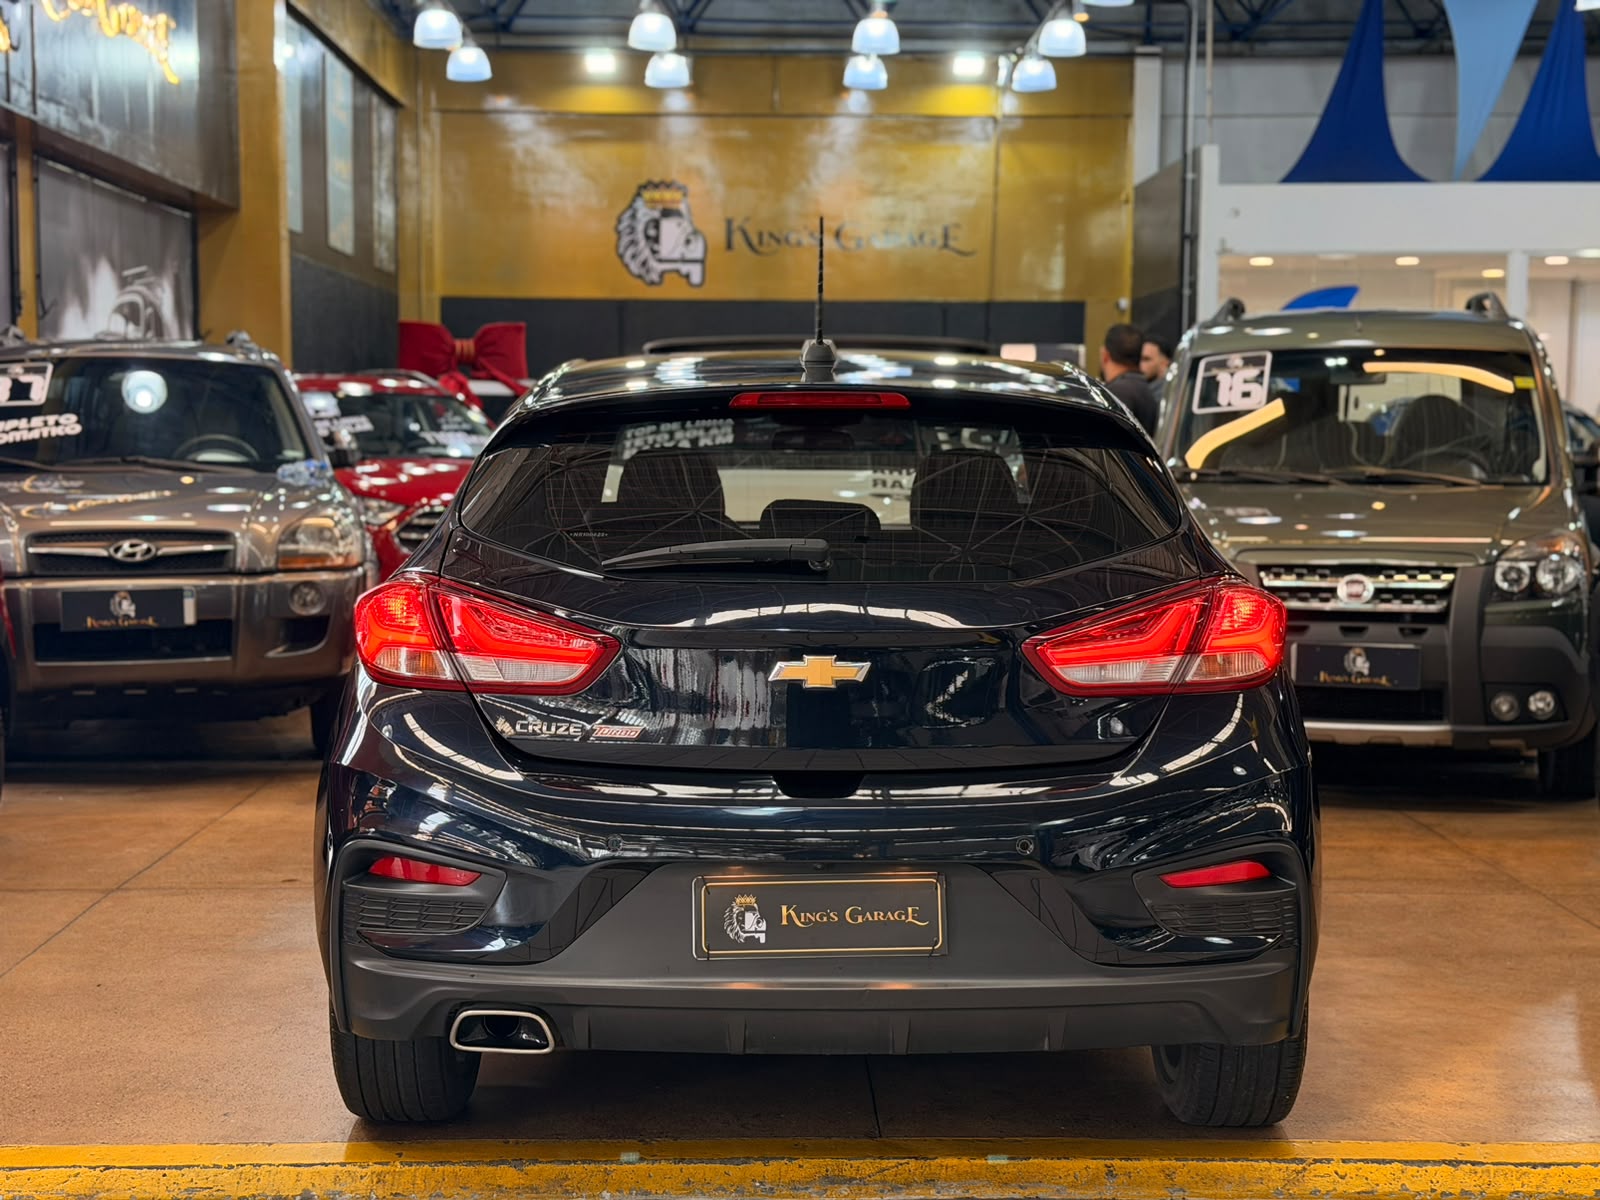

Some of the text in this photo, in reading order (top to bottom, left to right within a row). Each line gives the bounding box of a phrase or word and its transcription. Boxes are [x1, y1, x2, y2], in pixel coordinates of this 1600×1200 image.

[1216, 368, 1263, 408] 16
[0, 413, 78, 432] PLETO
[515, 720, 642, 738] CRUZE TURBO
[780, 904, 930, 928] KING'S GARAGE
